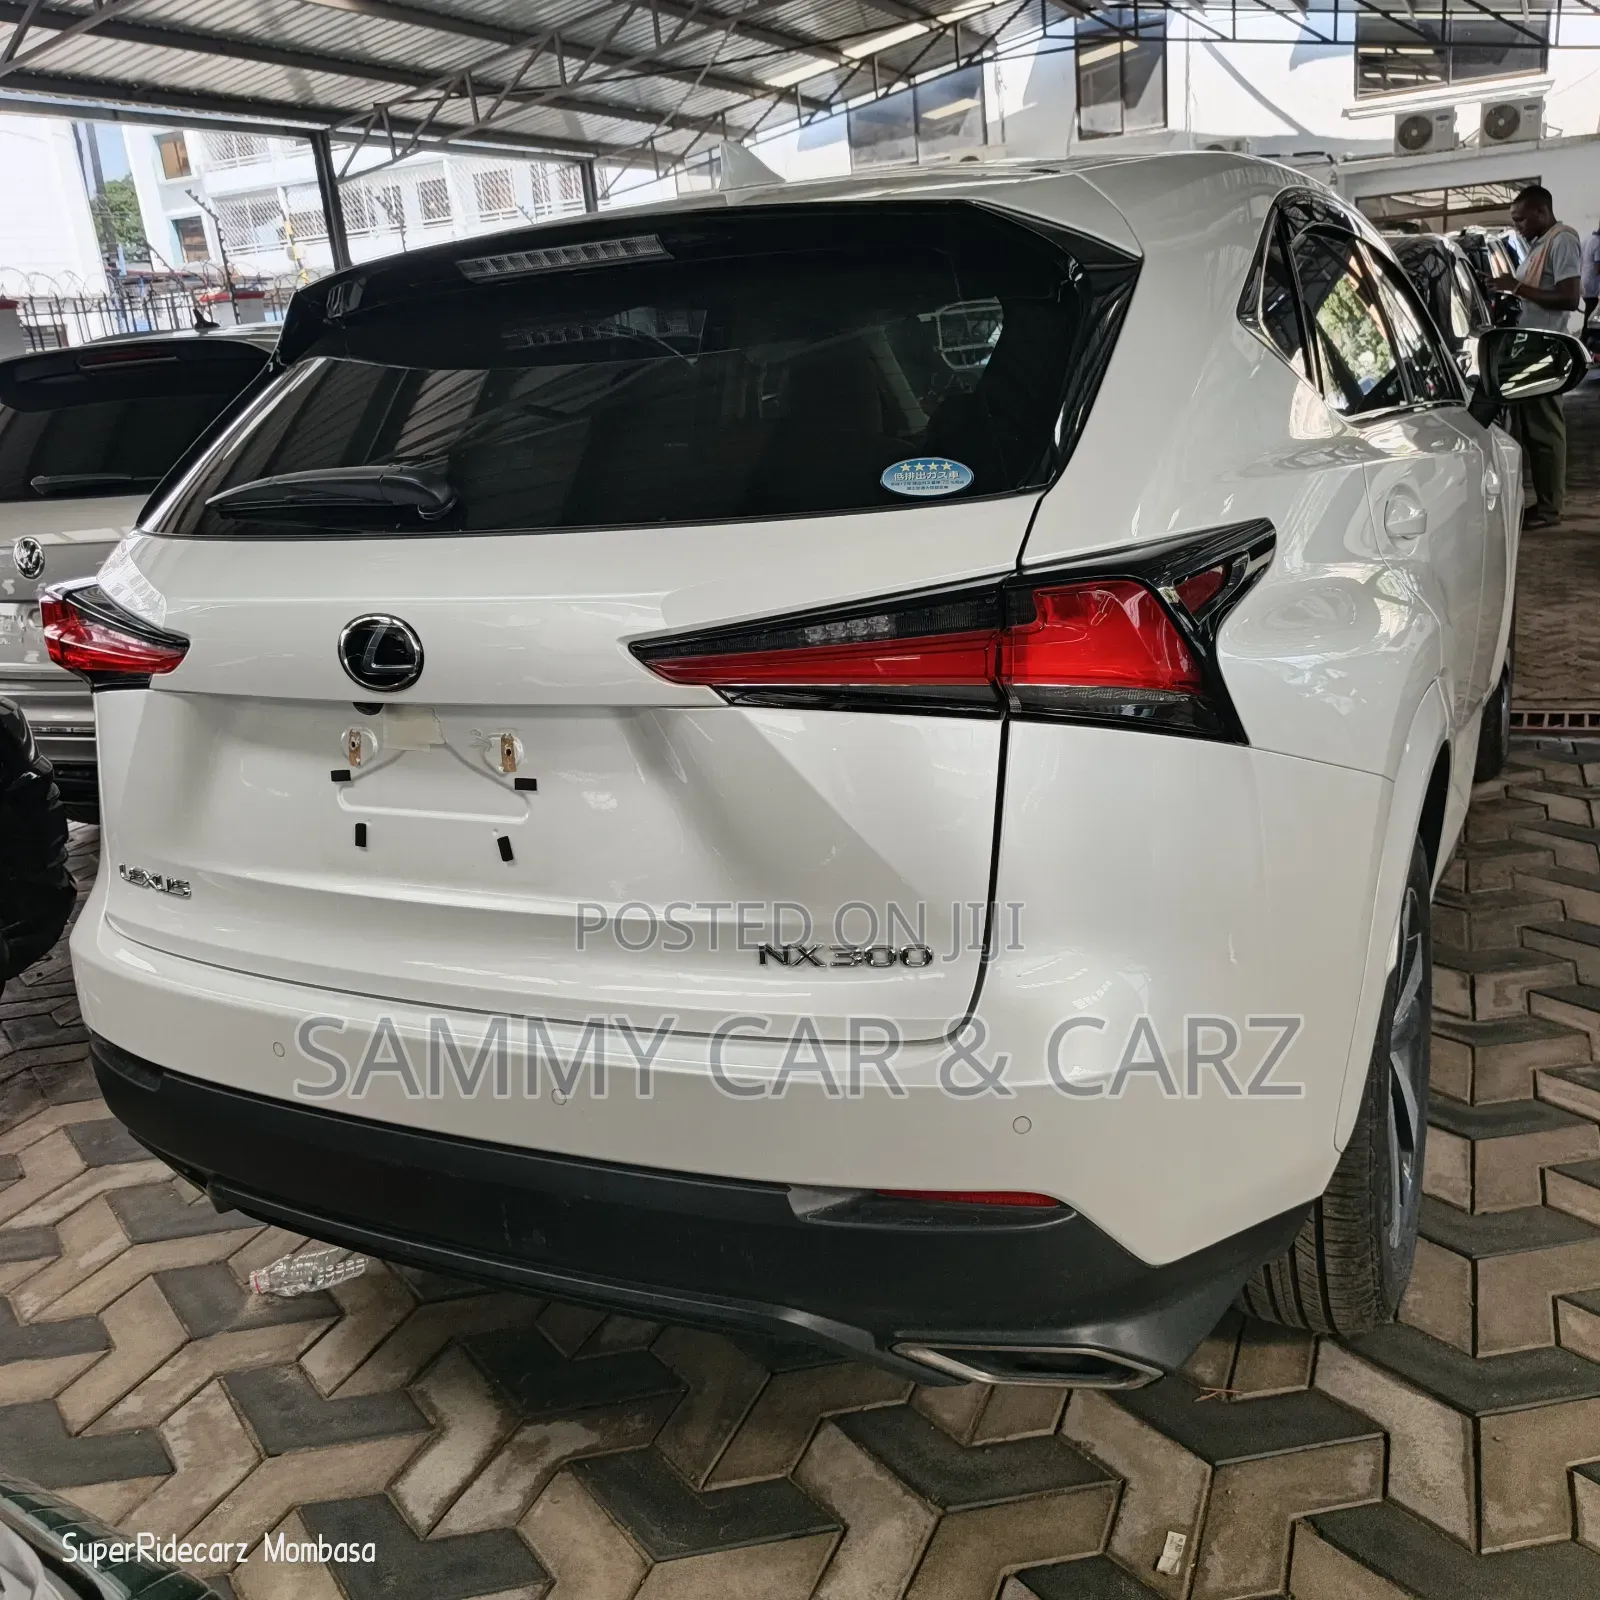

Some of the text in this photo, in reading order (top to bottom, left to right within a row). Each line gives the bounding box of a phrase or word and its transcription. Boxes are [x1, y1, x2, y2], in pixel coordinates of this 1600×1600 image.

[893, 471, 960, 480] 低排出ガス車
[119, 863, 191, 897] LEXUS
